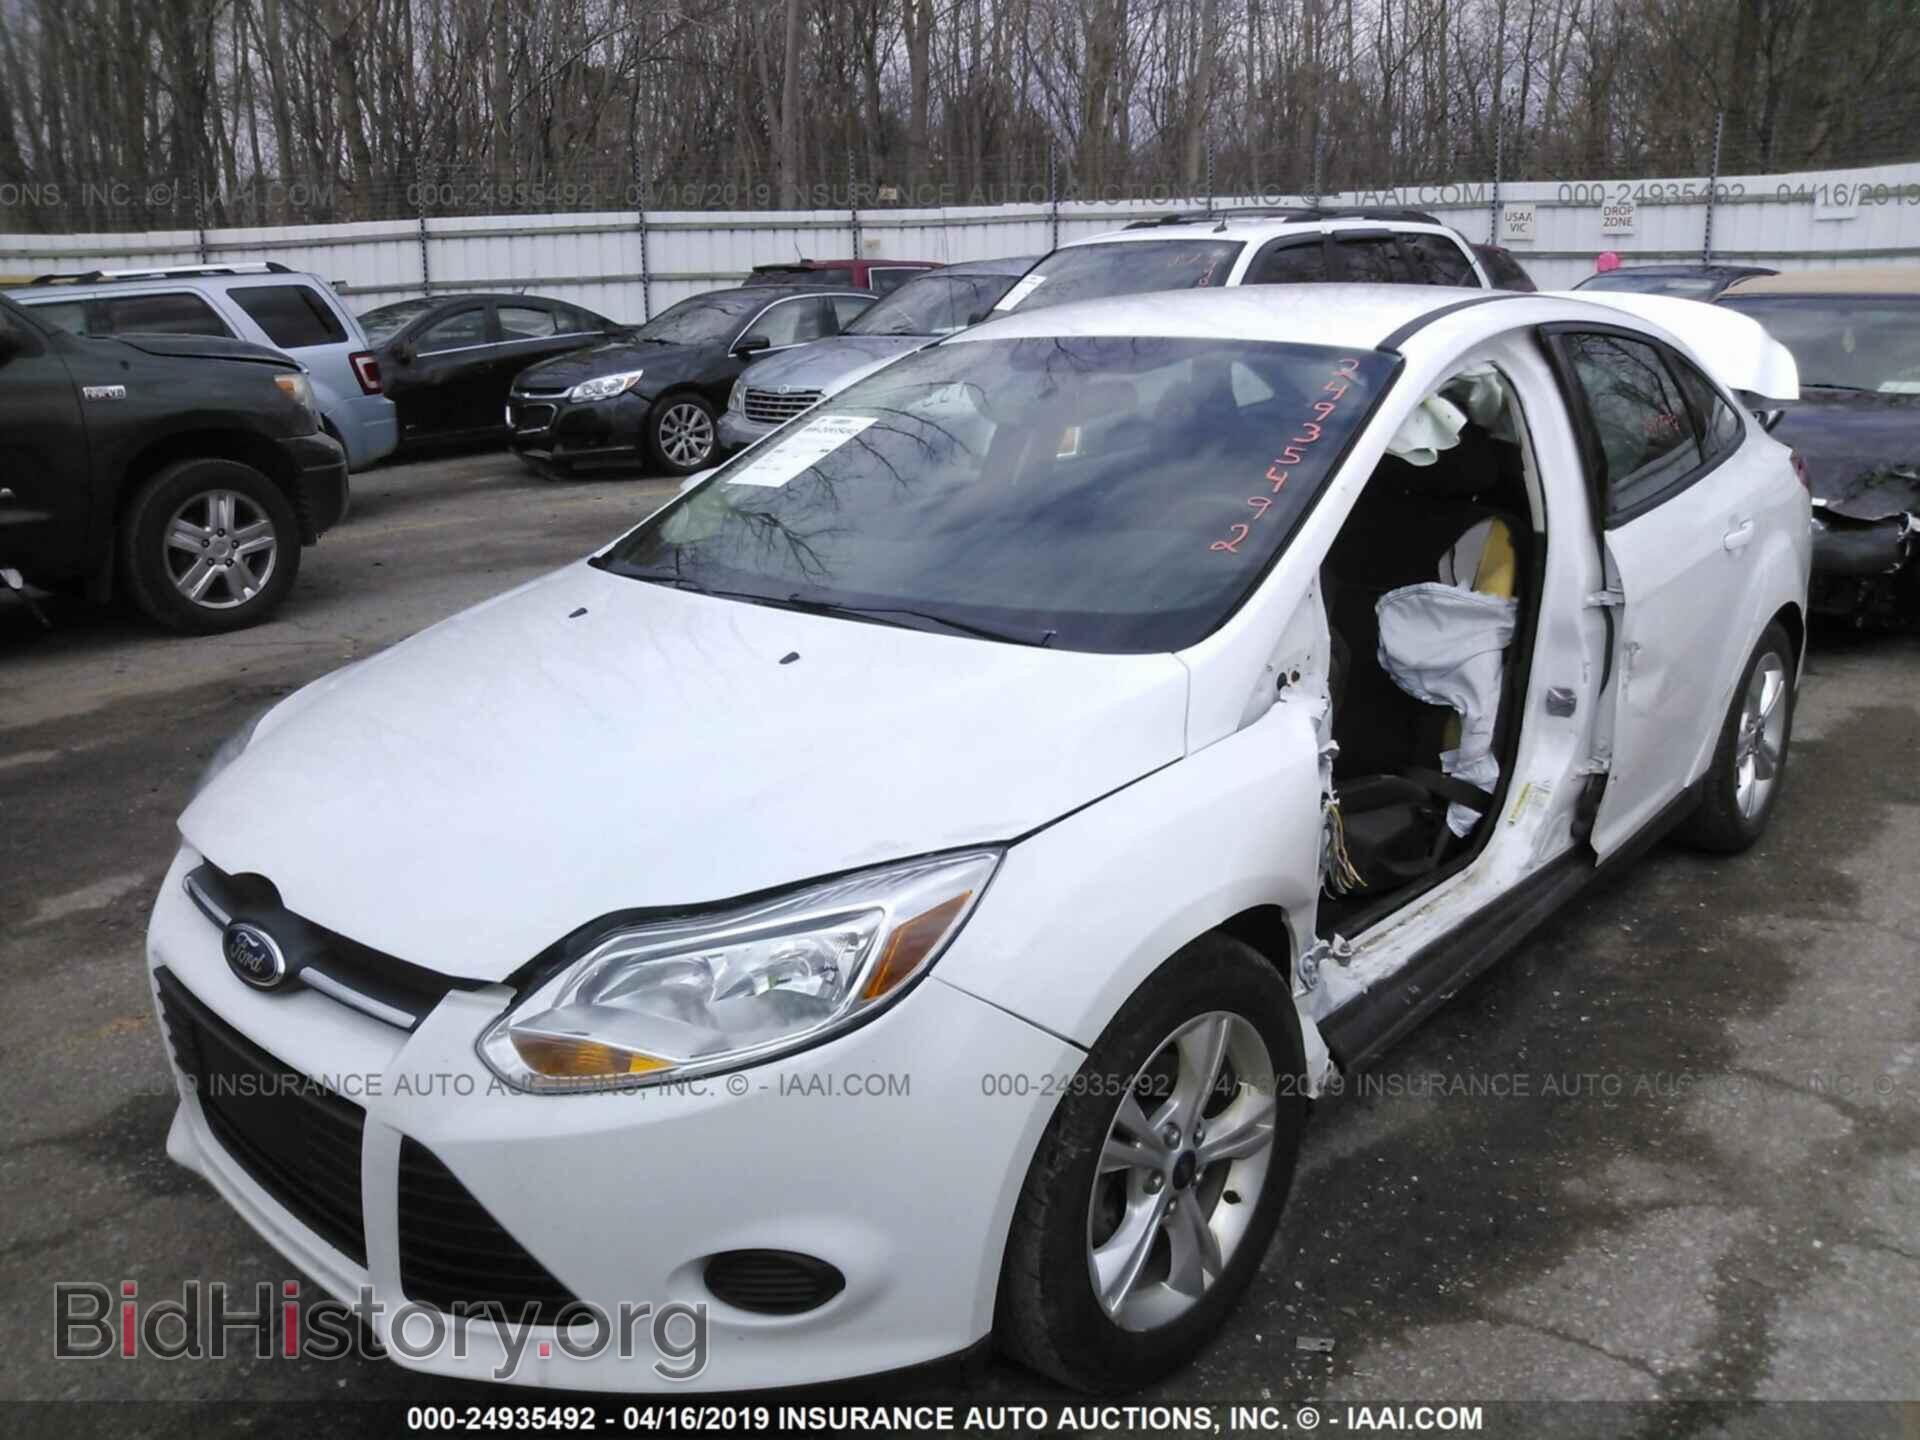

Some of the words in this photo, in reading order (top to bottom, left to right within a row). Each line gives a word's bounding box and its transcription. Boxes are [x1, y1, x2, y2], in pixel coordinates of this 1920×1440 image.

[1603, 206, 1634, 217] DROP
[1504, 212, 1533, 223] USAA
[1603, 217, 1633, 227] ZONE
[1509, 222, 1527, 233] VIC
[230, 930, 267, 973] Ford
